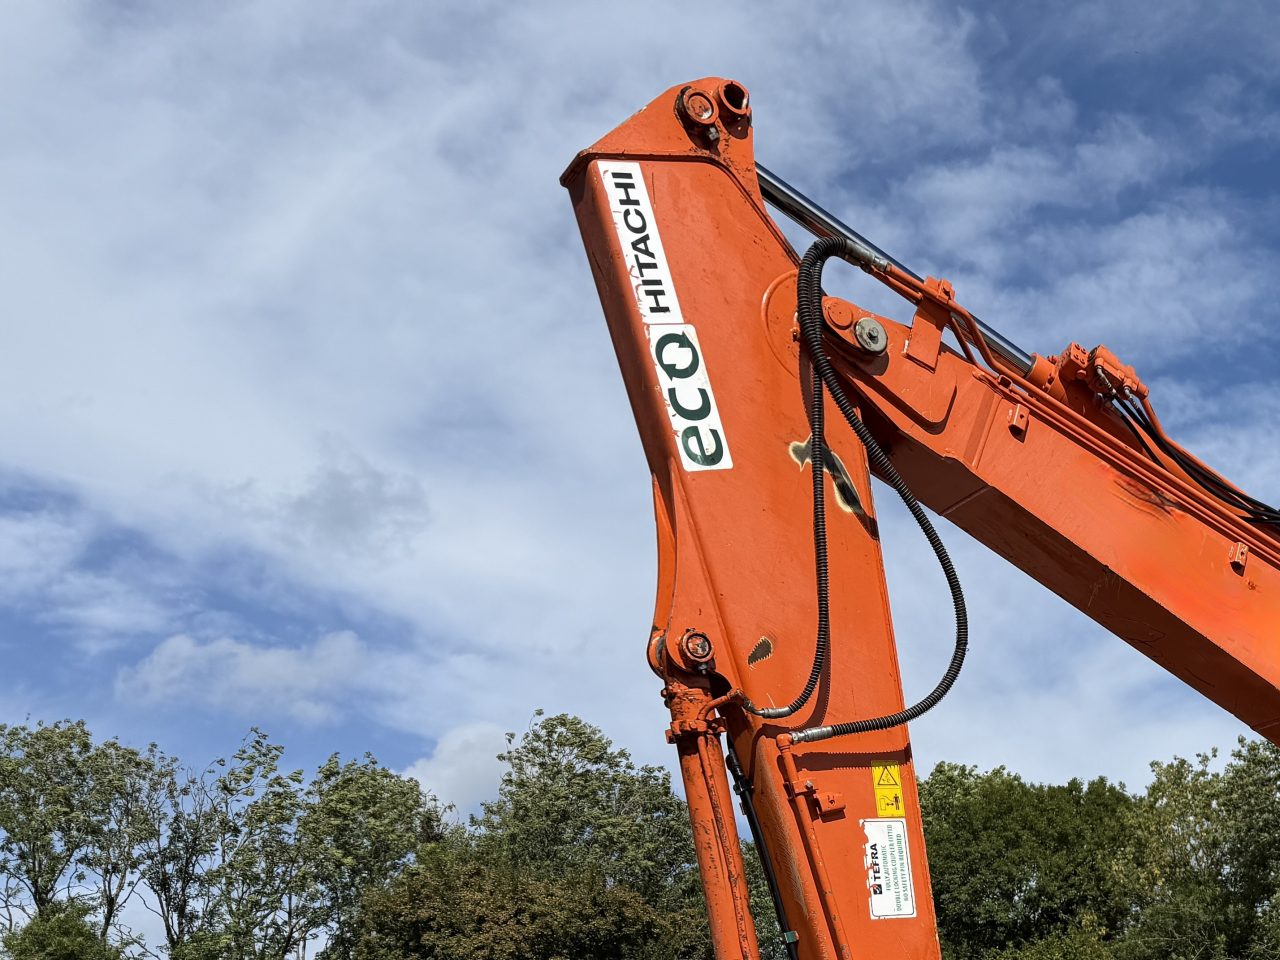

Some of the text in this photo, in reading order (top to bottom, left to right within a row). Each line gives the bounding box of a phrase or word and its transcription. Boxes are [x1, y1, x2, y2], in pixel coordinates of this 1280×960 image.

[611, 172, 671, 314] HITACHI
[881, 845, 890, 875] AUTOMATIC
[889, 843, 897, 866] COUPLER
[896, 833, 904, 862] REQUIRED
[894, 890, 902, 911] DOUBLE
